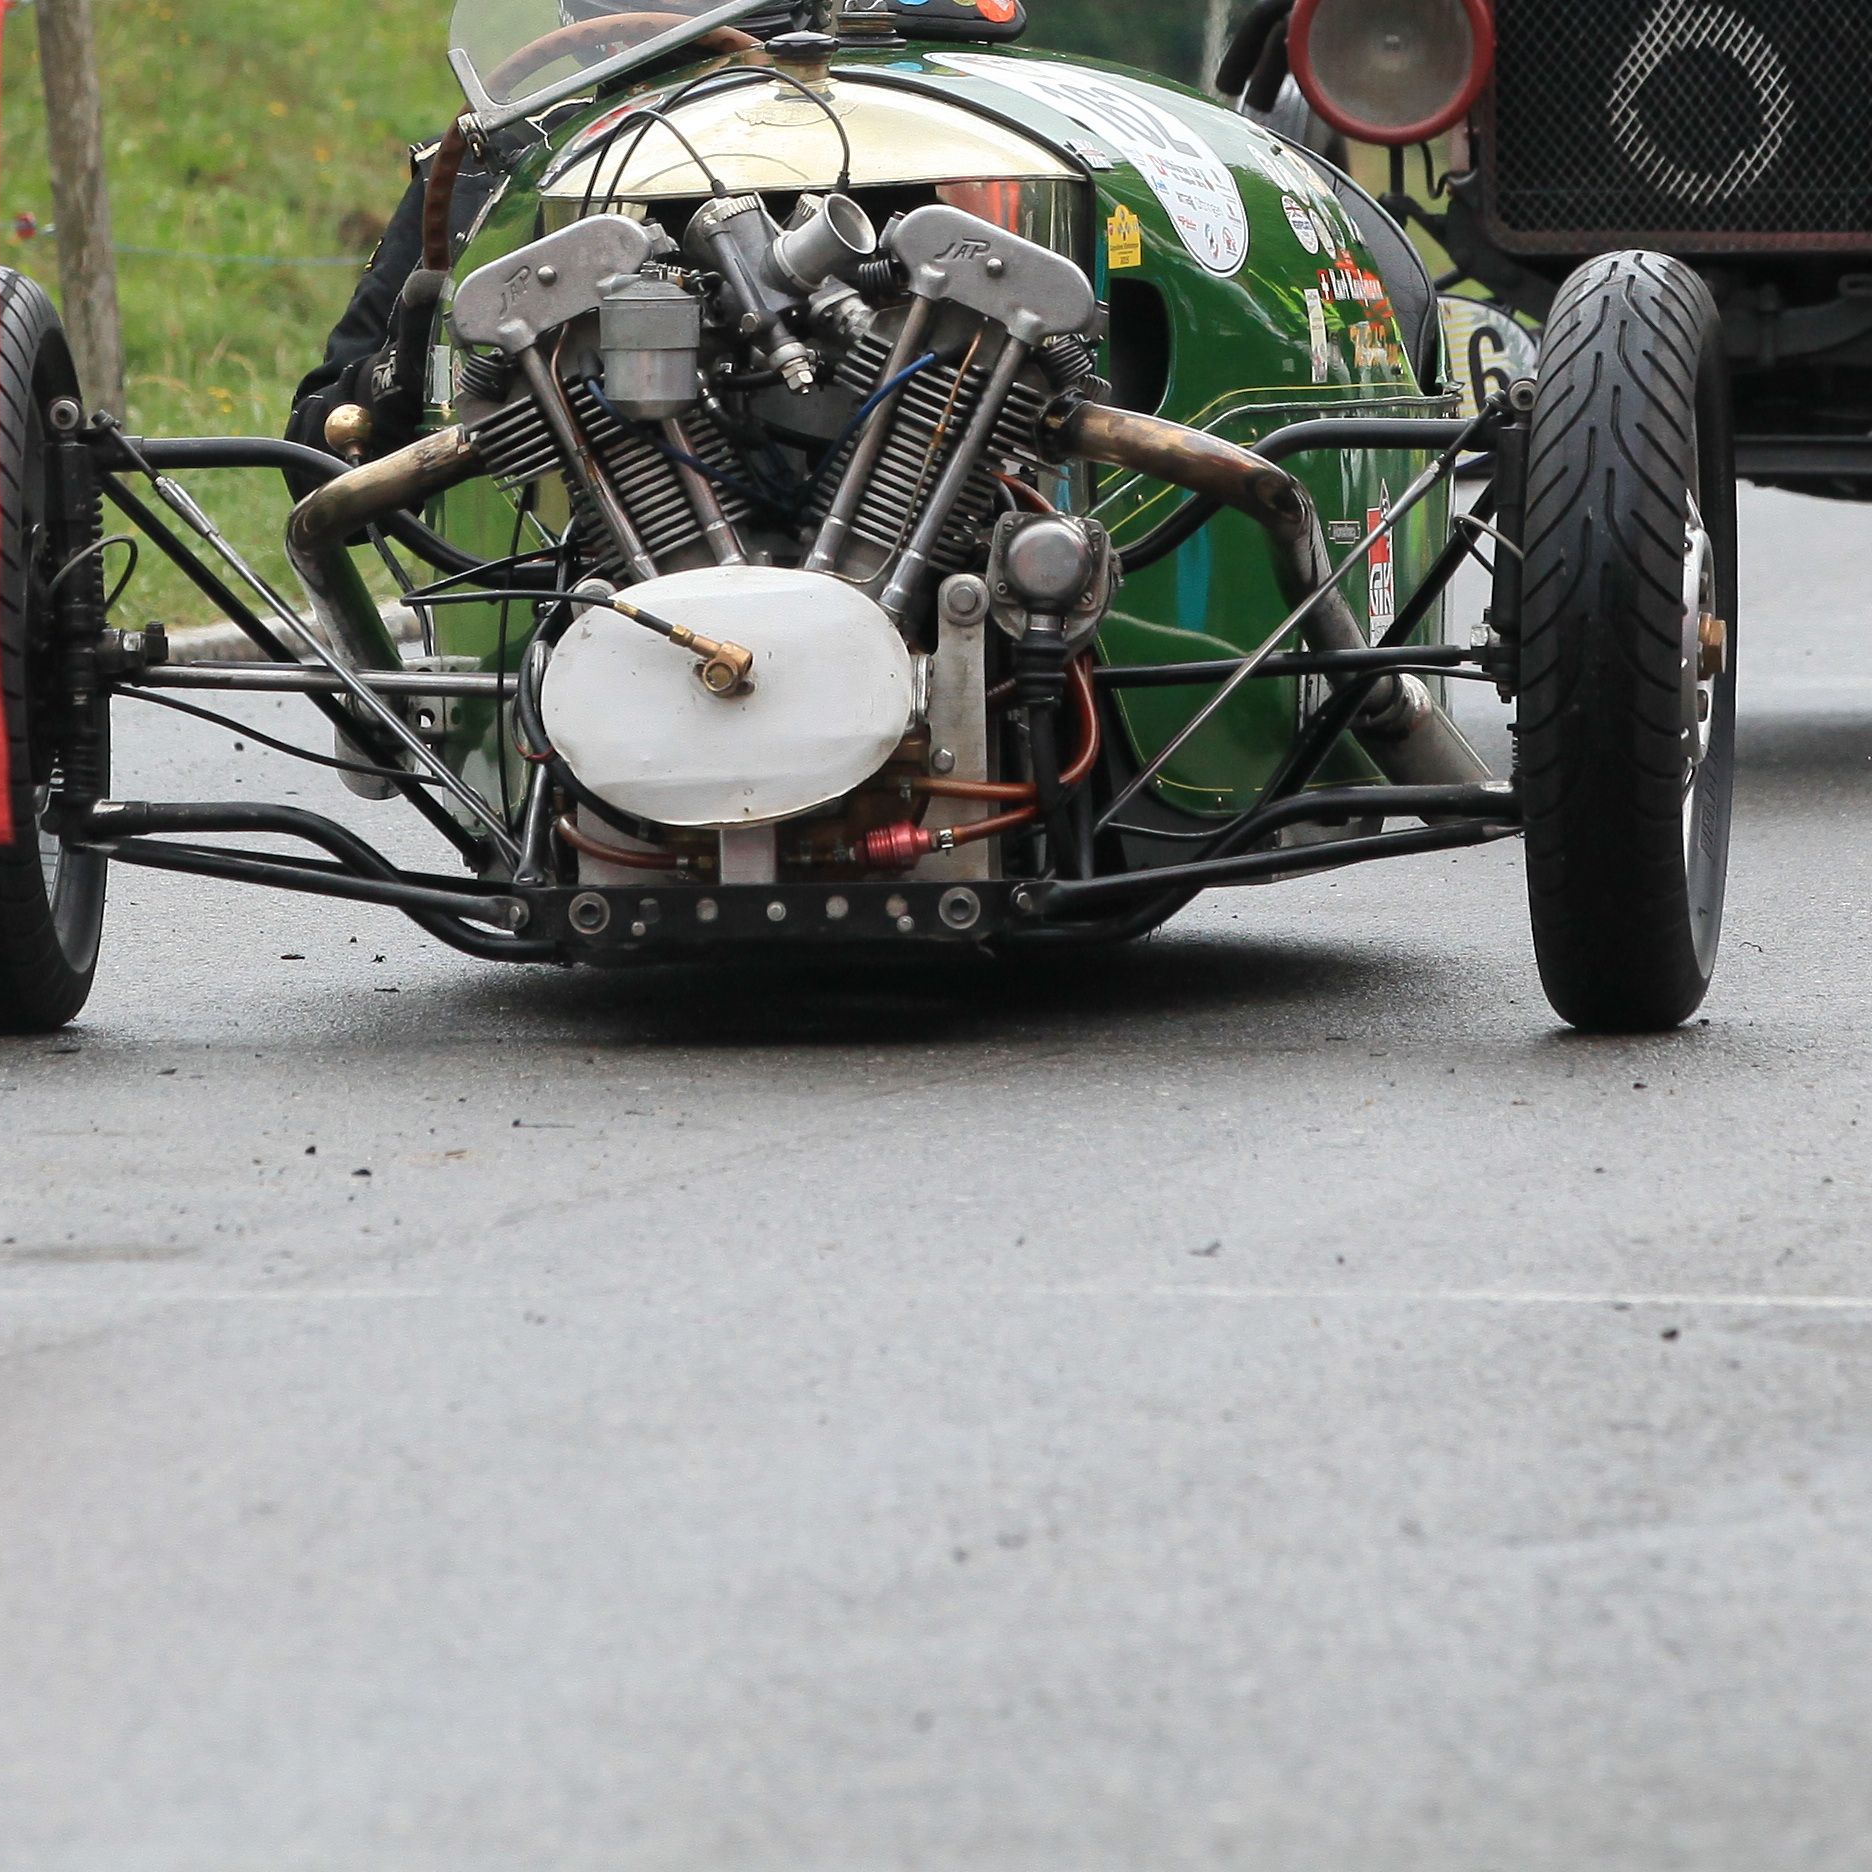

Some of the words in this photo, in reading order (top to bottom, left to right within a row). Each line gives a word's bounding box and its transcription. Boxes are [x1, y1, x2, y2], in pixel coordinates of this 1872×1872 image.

[1031, 80, 1202, 160] 162
[933, 236, 992, 261] JAP
[499, 264, 532, 319] JAP
[1469, 326, 1512, 416] 6
